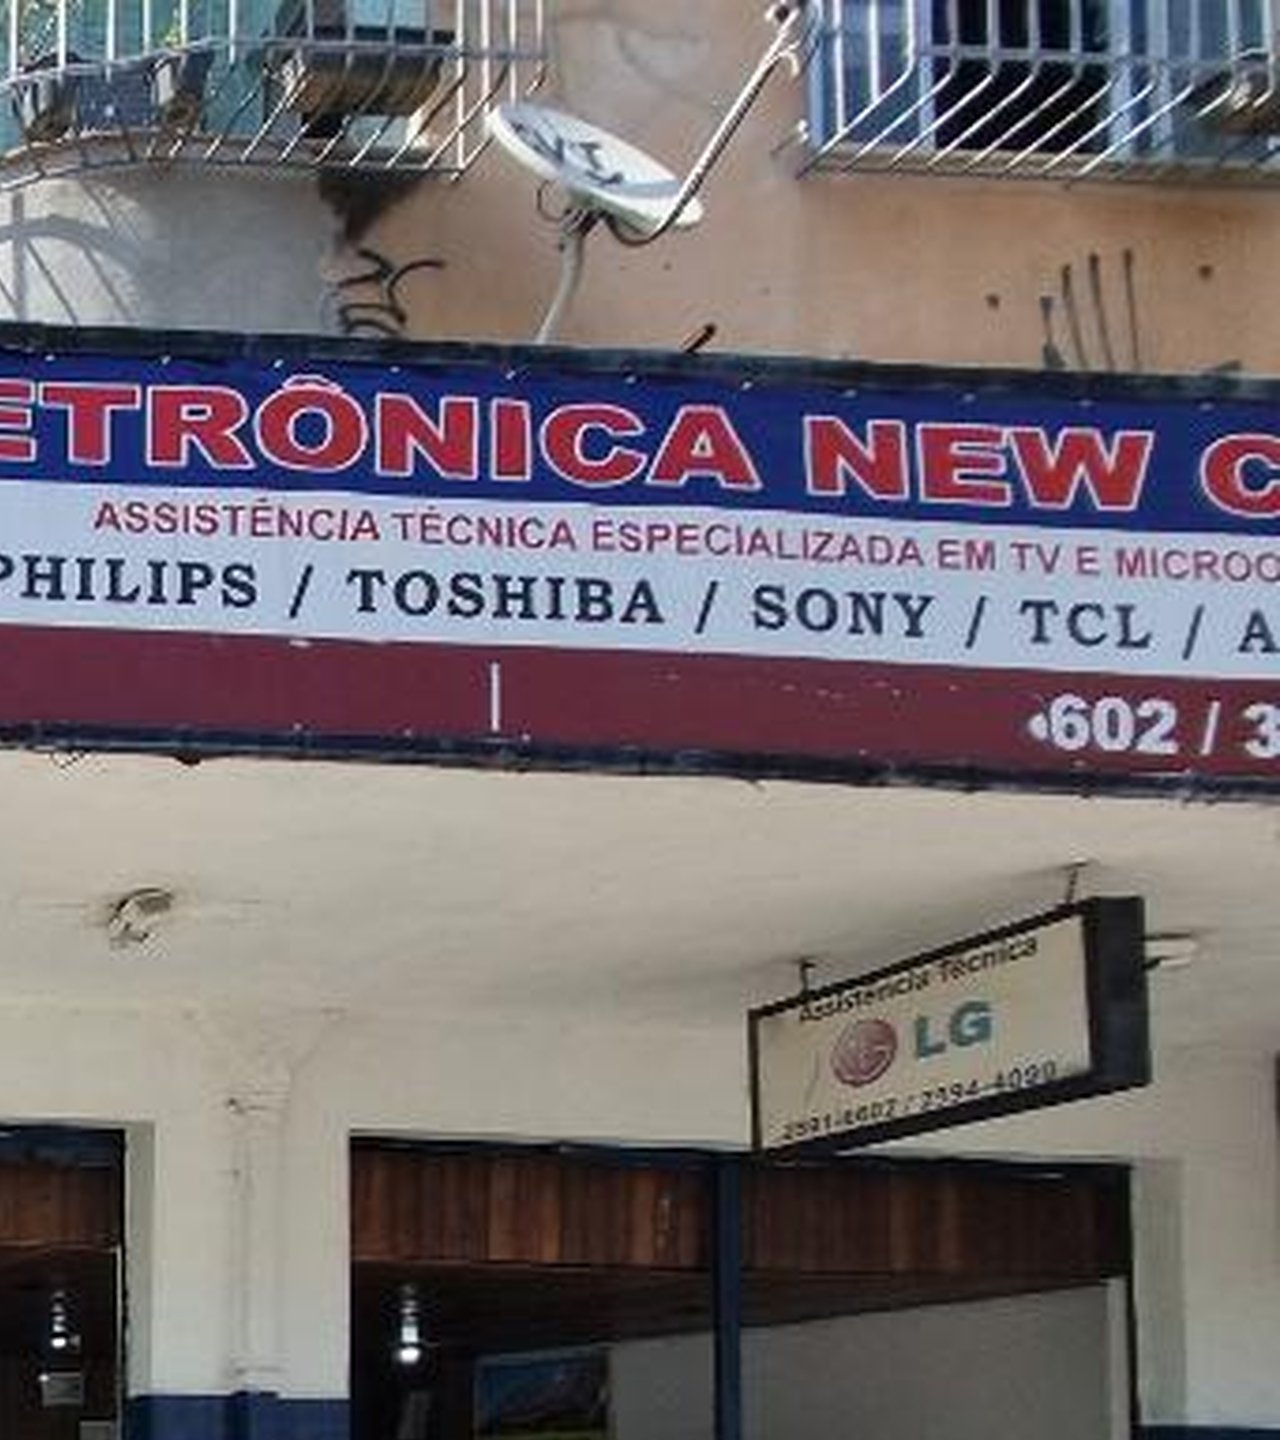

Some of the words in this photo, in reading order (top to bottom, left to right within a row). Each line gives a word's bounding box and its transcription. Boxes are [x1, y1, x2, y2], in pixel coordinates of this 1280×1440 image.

[803, 415, 1154, 512] NEW
[1200, 433, 1280, 518] C
[94, 498, 380, 541] ASSISTÊNCIA
[392, 505, 576, 550] TÉCNICA
[592, 519, 924, 568] ESPECIALIZADA
[939, 539, 996, 571] EM
[1010, 542, 1061, 575] TV
[1076, 544, 1100, 576] E
[346, 569, 665, 625] TOSHIBA
[752, 583, 937, 639] SONY
[1020, 600, 1152, 649] TCL
[914, 1002, 992, 1059] LG
